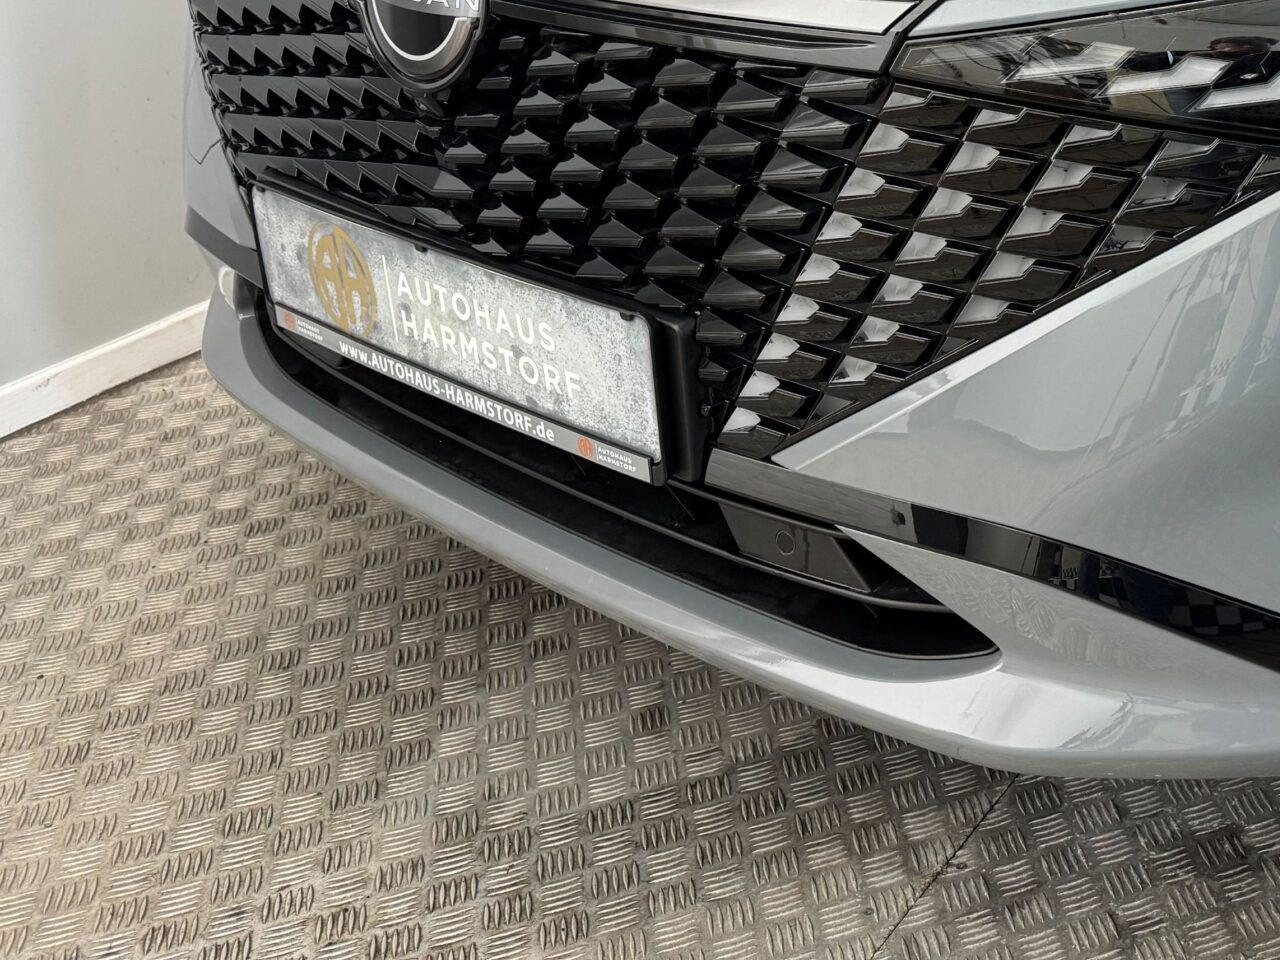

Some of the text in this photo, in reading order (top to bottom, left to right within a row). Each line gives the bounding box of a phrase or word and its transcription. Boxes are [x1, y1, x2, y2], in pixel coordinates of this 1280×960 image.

[397, 271, 555, 352] AUTOHAUS
[339, 340, 555, 442] www.AUTOHAUS-HARMSTORF.de
[400, 309, 581, 399] HARMSTORF
[597, 446, 632, 464] AUTOHAUS
[598, 453, 636, 473] HARMSTORF
